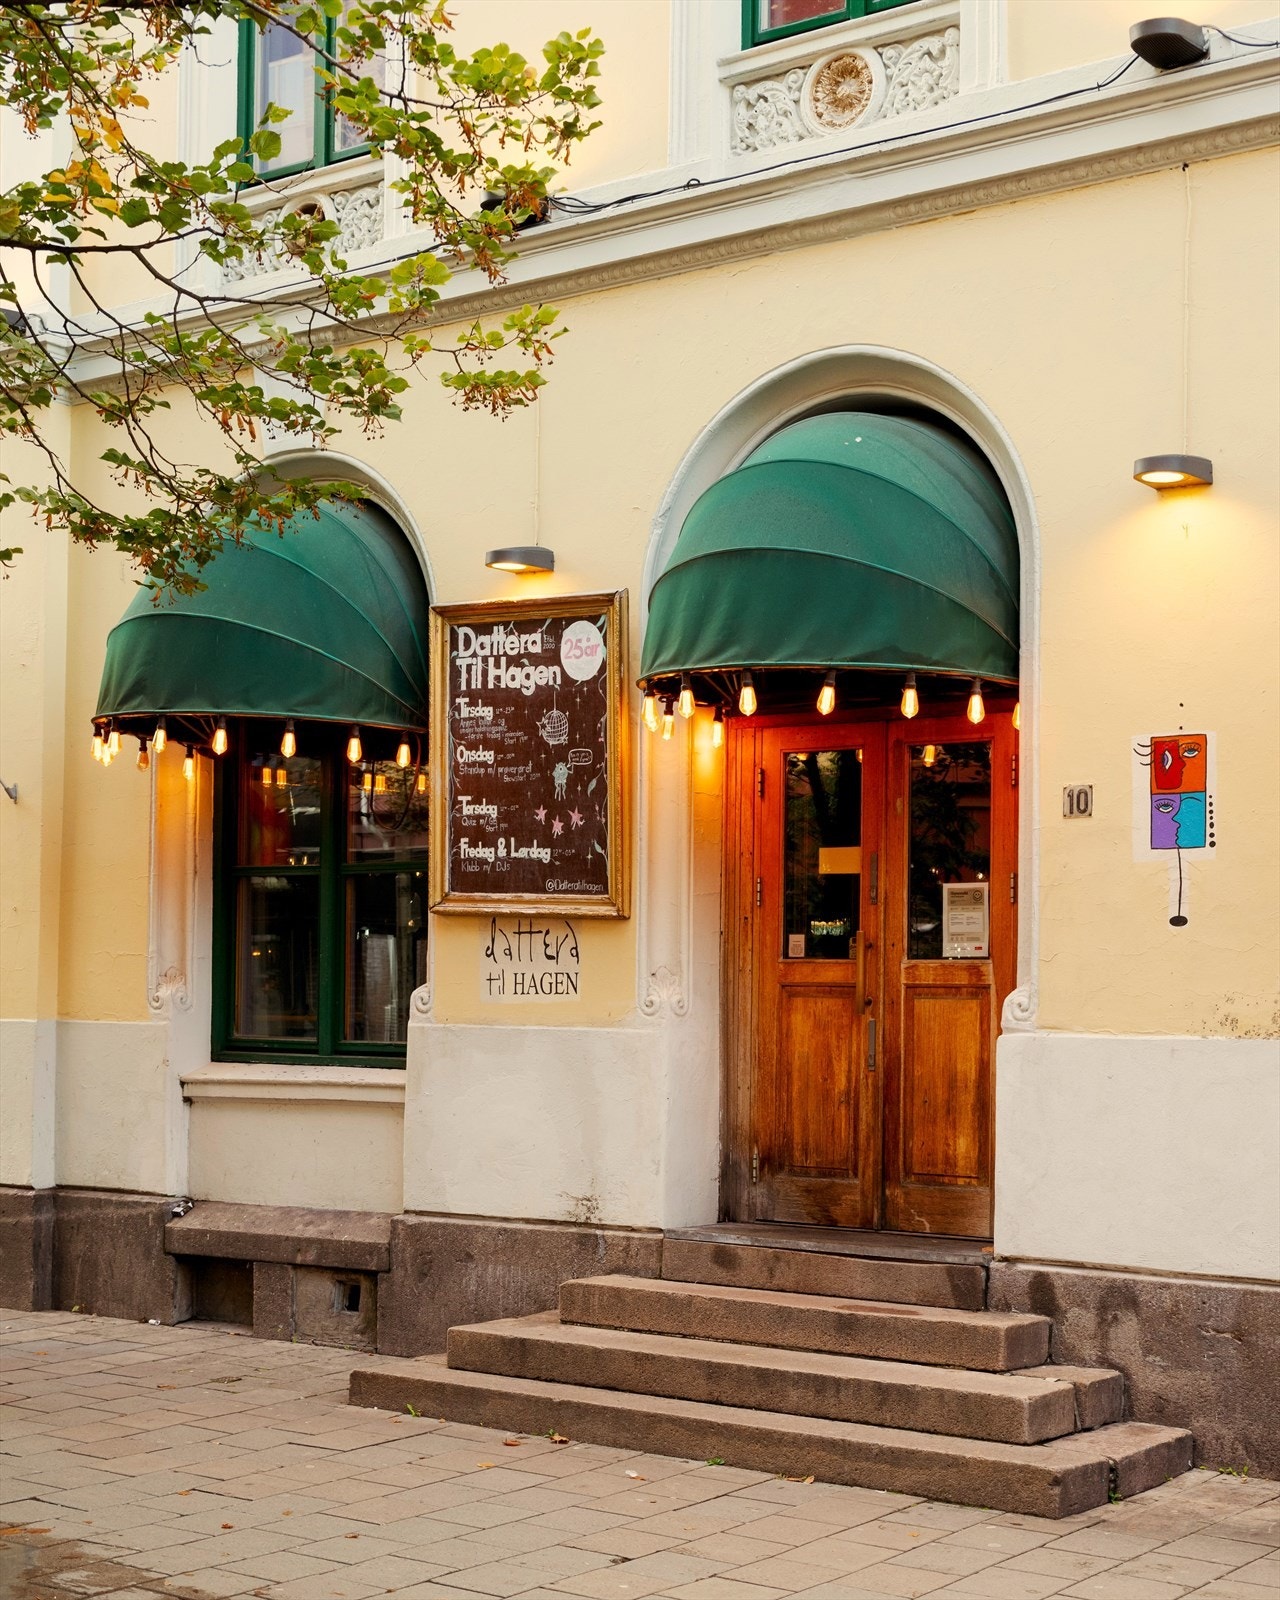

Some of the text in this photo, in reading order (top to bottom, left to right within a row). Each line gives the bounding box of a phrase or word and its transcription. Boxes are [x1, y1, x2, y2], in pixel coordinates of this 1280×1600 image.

[458, 625, 542, 657] Dattera
[564, 637, 600, 660] 25 år
[456, 657, 561, 696] Til Hagen
[456, 697, 493, 720] Tirsdag
[457, 745, 494, 764] Onsdag
[459, 763, 486, 778] Standup
[457, 795, 497, 818] Torsdag
[1067, 788, 1088, 815] 10
[461, 817, 477, 827] Quiz
[460, 837, 495, 863] Fredag
[497, 837, 507, 857] &
[510, 837, 551, 864] Lørdag
[461, 861, 480, 873] Klubb
[496, 861, 511, 872] DJs
[485, 916, 580, 965] dattera
[486, 968, 579, 995] til HAGEN
